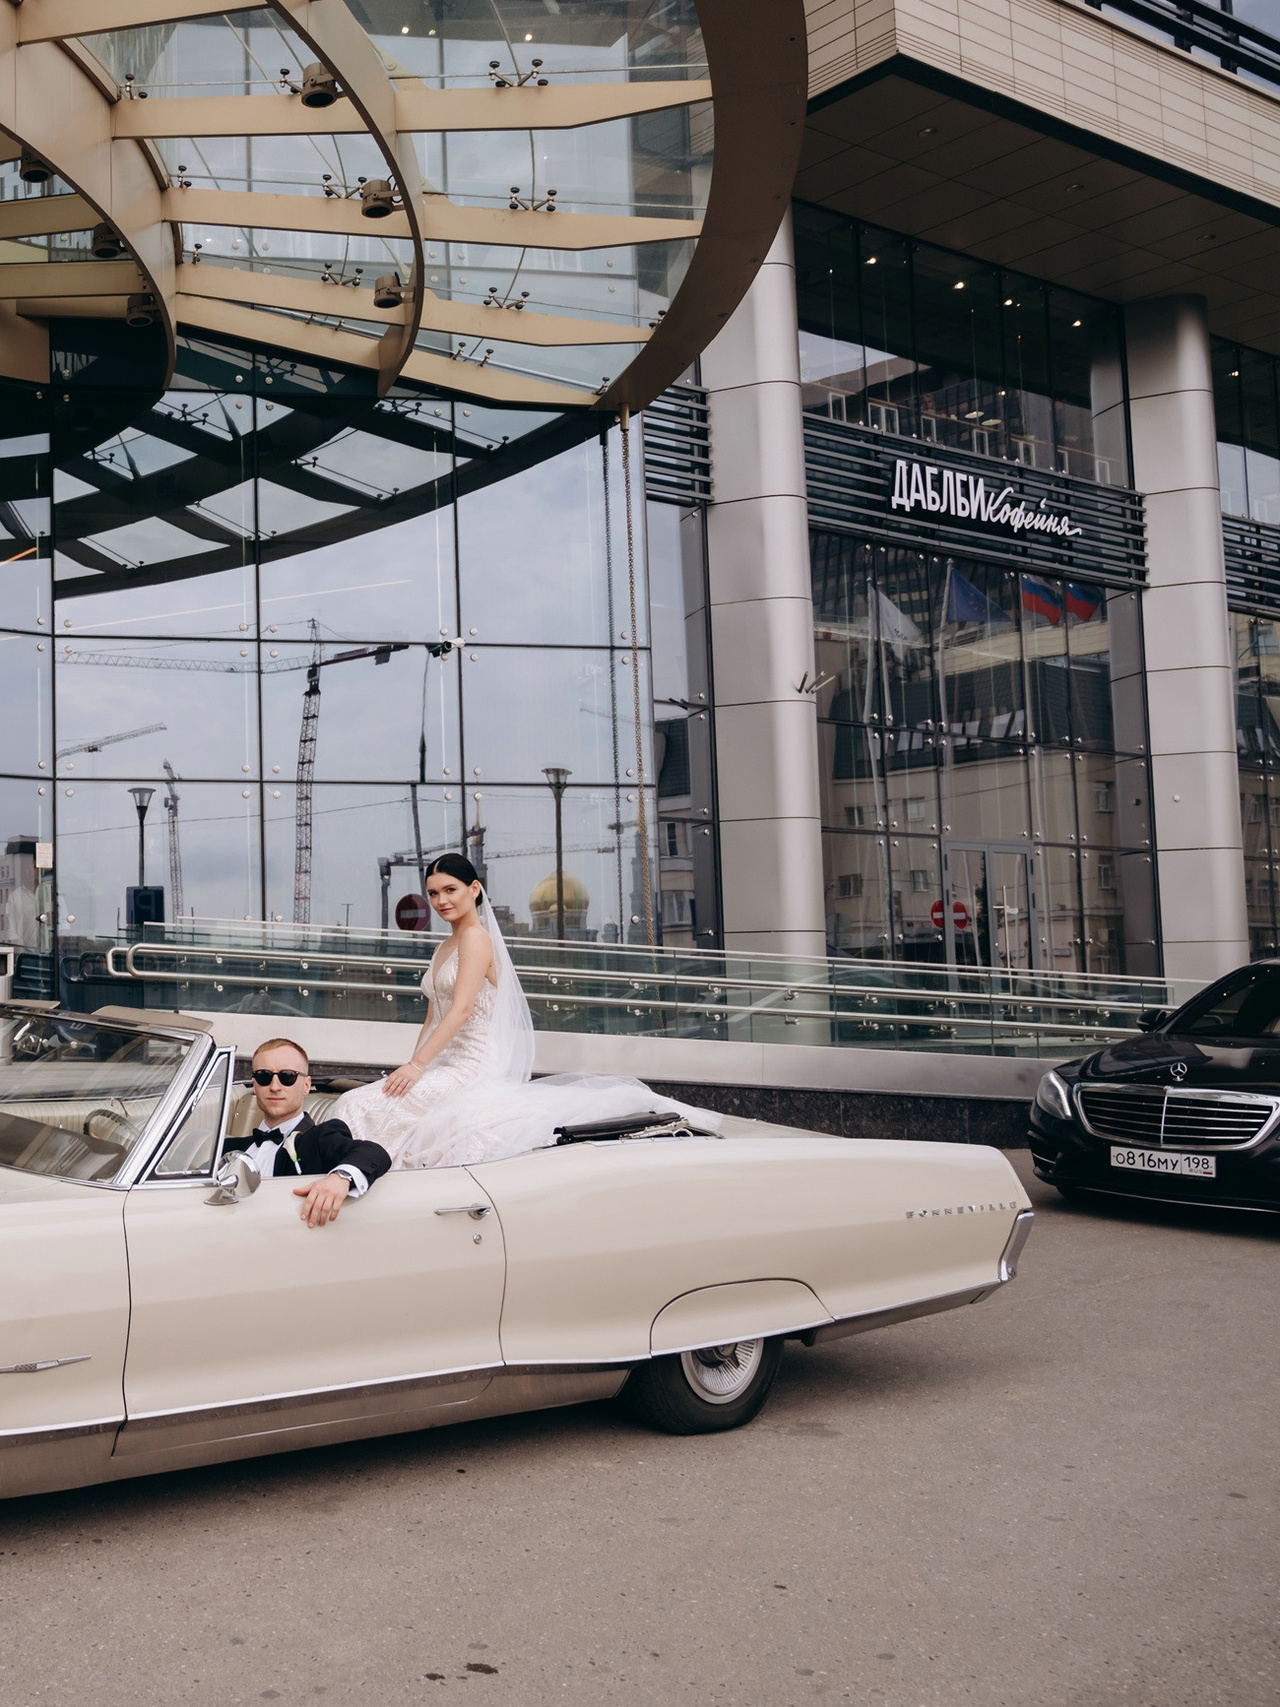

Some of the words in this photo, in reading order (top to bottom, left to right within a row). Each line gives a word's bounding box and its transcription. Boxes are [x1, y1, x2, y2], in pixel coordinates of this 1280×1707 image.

[891, 459, 988, 522] ДАБЛБИ
[986, 486, 1082, 536] Кофейня
[1183, 1156, 1210, 1170] 198
